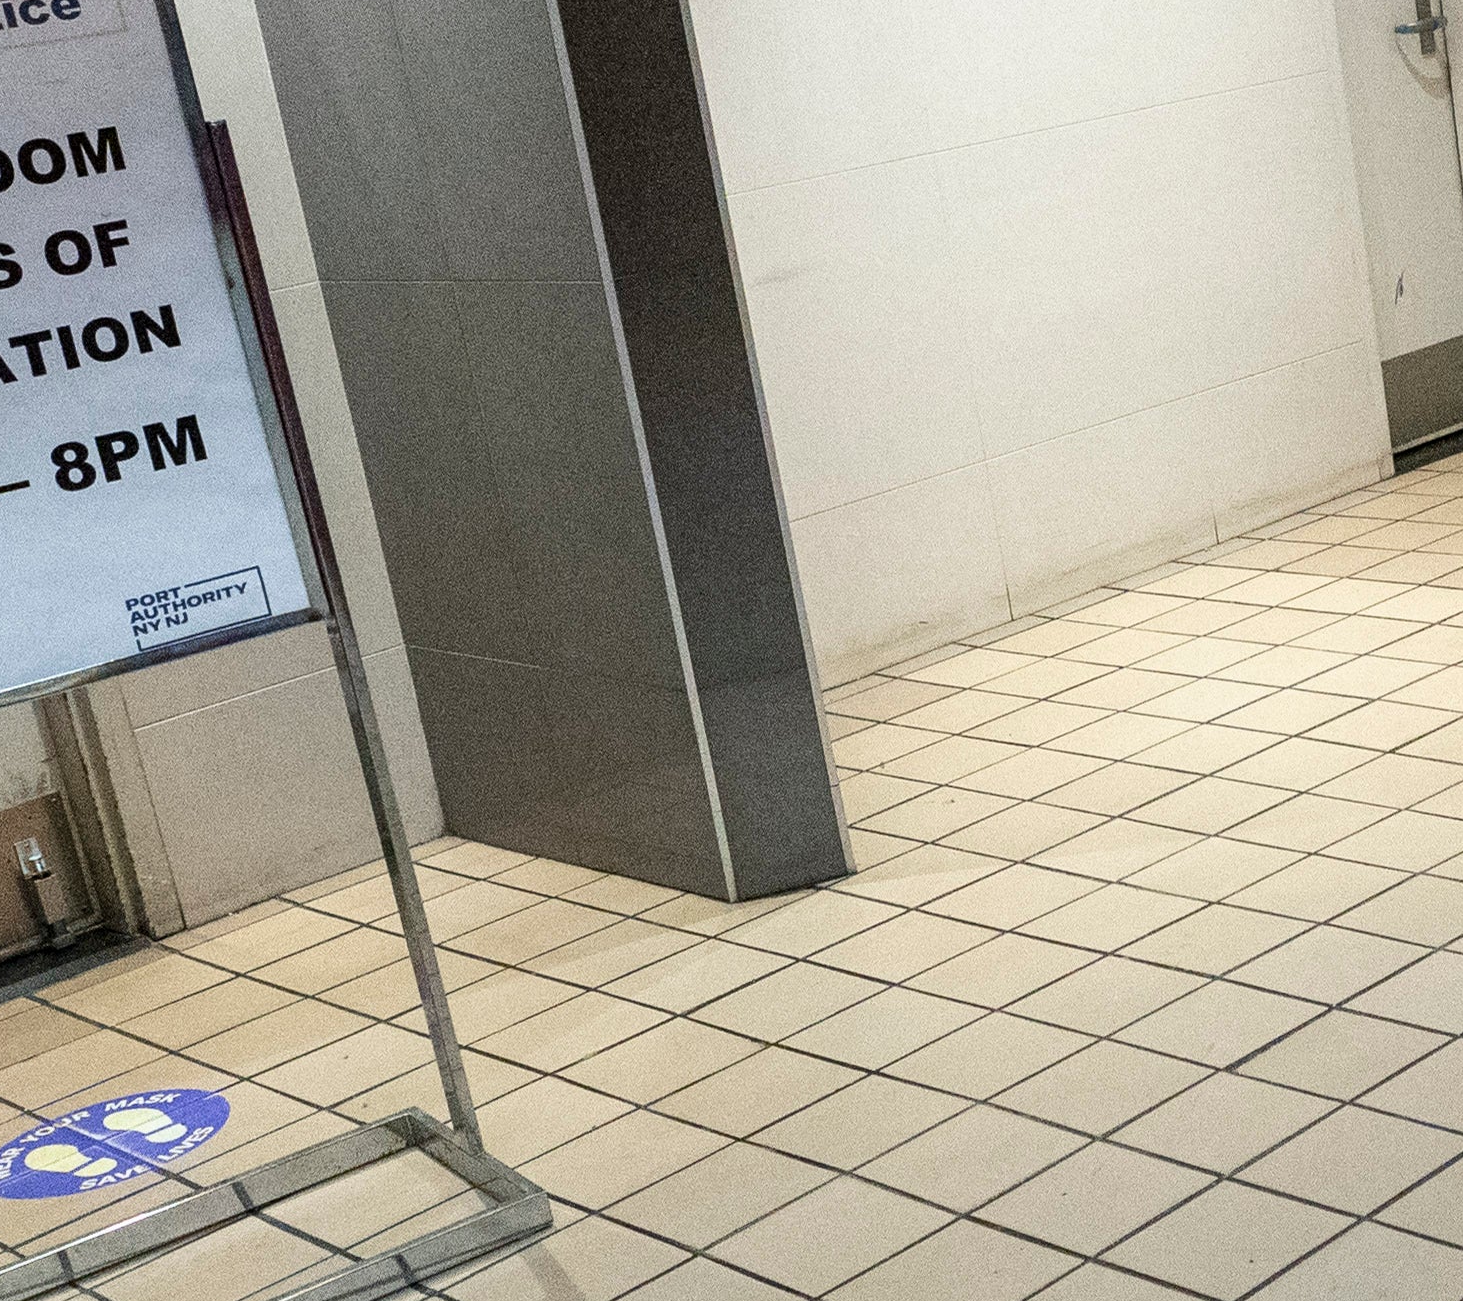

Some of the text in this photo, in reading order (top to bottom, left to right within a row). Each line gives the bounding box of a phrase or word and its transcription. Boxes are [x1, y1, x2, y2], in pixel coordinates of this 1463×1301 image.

[43, 218, 130, 276] OF
[50, 414, 208, 492] 8PM
[125, 586, 182, 612] PORT
[130, 582, 248, 625] AUTHORITY
[132, 612, 188, 637] NY NJ
[19, 1110, 91, 1144] YOUR
[104, 1092, 182, 1112] MASK
[79, 1126, 215, 1190] SAVE LIVES
